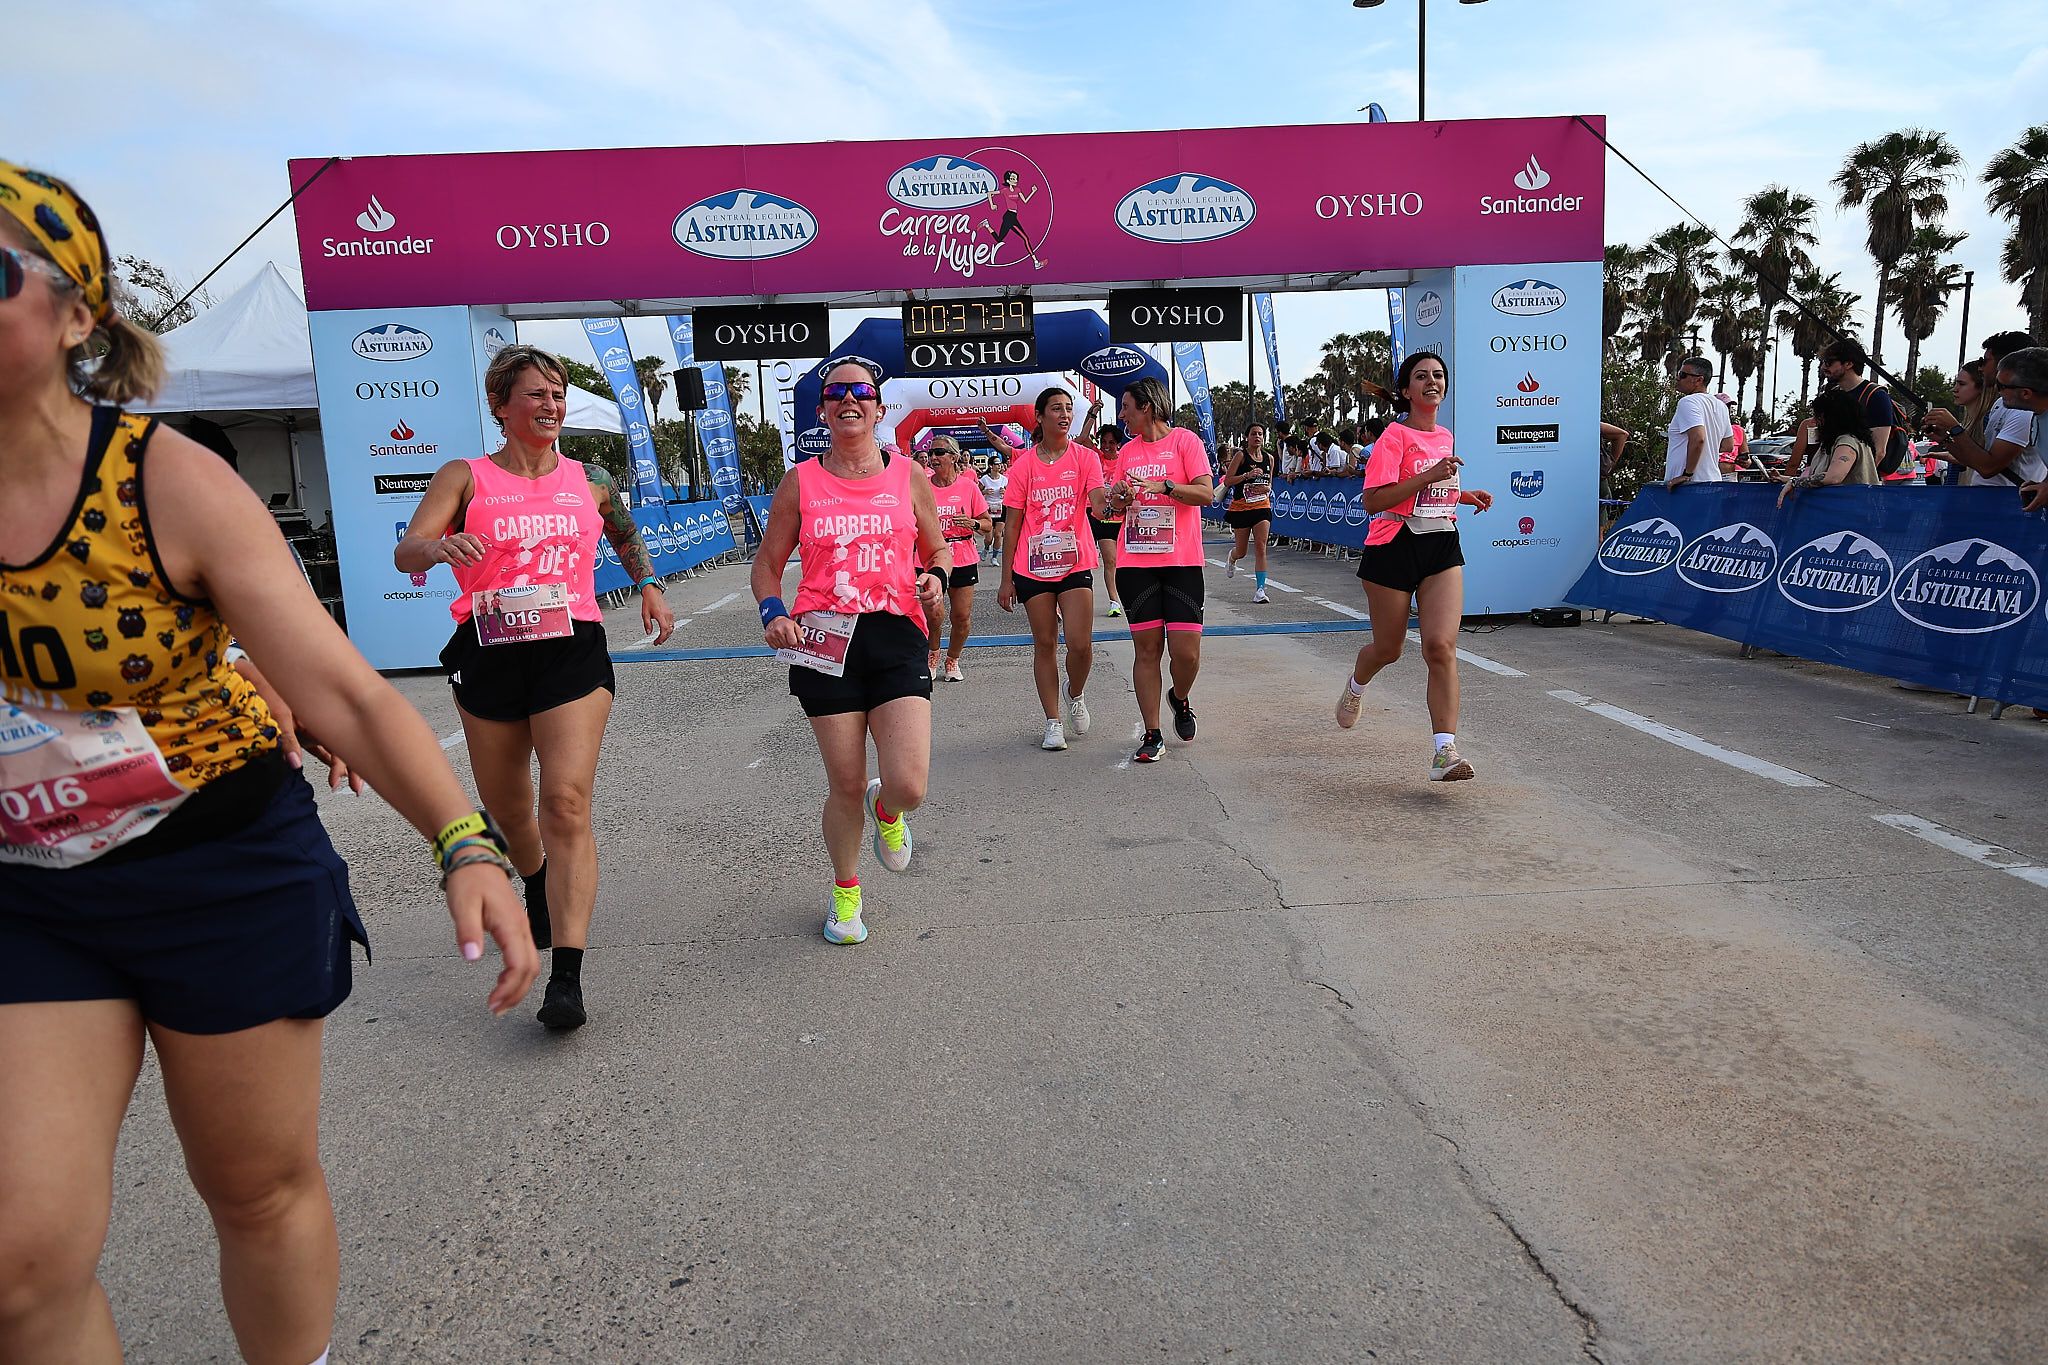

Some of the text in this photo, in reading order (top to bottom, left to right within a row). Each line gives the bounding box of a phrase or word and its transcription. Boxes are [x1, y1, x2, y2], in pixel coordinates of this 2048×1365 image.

[912, 172, 986, 181] CENTRAL LECHERA
[896, 177, 990, 197] ASTURIANA
[1147, 196, 1241, 206] CENTRAL LECHERA
[1316, 192, 1423, 219] OYSHO
[1480, 193, 1583, 215] Santander
[705, 212, 802, 222] CENTRAL LECHERA
[879, 208, 971, 236] Carrera
[1126, 201, 1246, 227] ASTURIANA
[496, 222, 610, 250] OYSHO
[684, 217, 808, 243] ASTURIANA
[322, 235, 434, 258] Santander
[903, 230, 1005, 278] de la Mujer
[1497, 294, 1561, 308] ASTURIANA
[912, 302, 1026, 334] 00:37:39
[1131, 305, 1225, 326] OYSHO
[715, 322, 810, 345] OYSHO
[358, 339, 428, 353] ASTURIANA
[1490, 334, 1567, 353] OYSHO
[910, 340, 1030, 368] OYSHO
[1086, 358, 1141, 371] ASTURIANA
[356, 380, 439, 400] OYSHO
[928, 377, 1022, 399] OYSHO
[1496, 394, 1561, 408] Santander
[929, 405, 1011, 416] Sports Santander
[800, 437, 832, 448] ASTURI
[1500, 429, 1554, 442] Neutrogena
[370, 443, 438, 456] Santander
[379, 478, 431, 491] Neutrogen
[1512, 476, 1542, 491] Marlene
[485, 494, 524, 506] OYSHO
[1031, 485, 1075, 502] CARRERA
[1431, 489, 1449, 498] 016
[809, 497, 843, 508] OYSHO
[1054, 503, 1070, 521] DE
[494, 514, 580, 542] CARRERA
[813, 514, 893, 539] CARRERA
[1139, 527, 1158, 535] 016
[1491, 537, 1561, 548] octopus energy
[1602, 535, 1672, 564] ASTURIANA
[1623, 535, 1677, 547] CENTRAL LECHERA
[857, 543, 884, 572] DE
[1043, 552, 1062, 560] 016
[1706, 544, 1771, 558] CENTRAL LECHERA
[538, 545, 570, 576] DE
[1680, 544, 1767, 580] ASTURIANA
[1808, 556, 1884, 572] CENTRAL LECHERA
[1782, 556, 1882, 597] ASTURIANA
[1927, 568, 2026, 585] CENTRAL LECHERA
[383, 588, 458, 601] octopus energy
[501, 585, 538, 595] ASTURIANA
[1897, 568, 2022, 615] ASTURIANA
[504, 609, 541, 626] 016
[810, 660, 834, 671] Santander
[0, 776, 89, 821] 016
